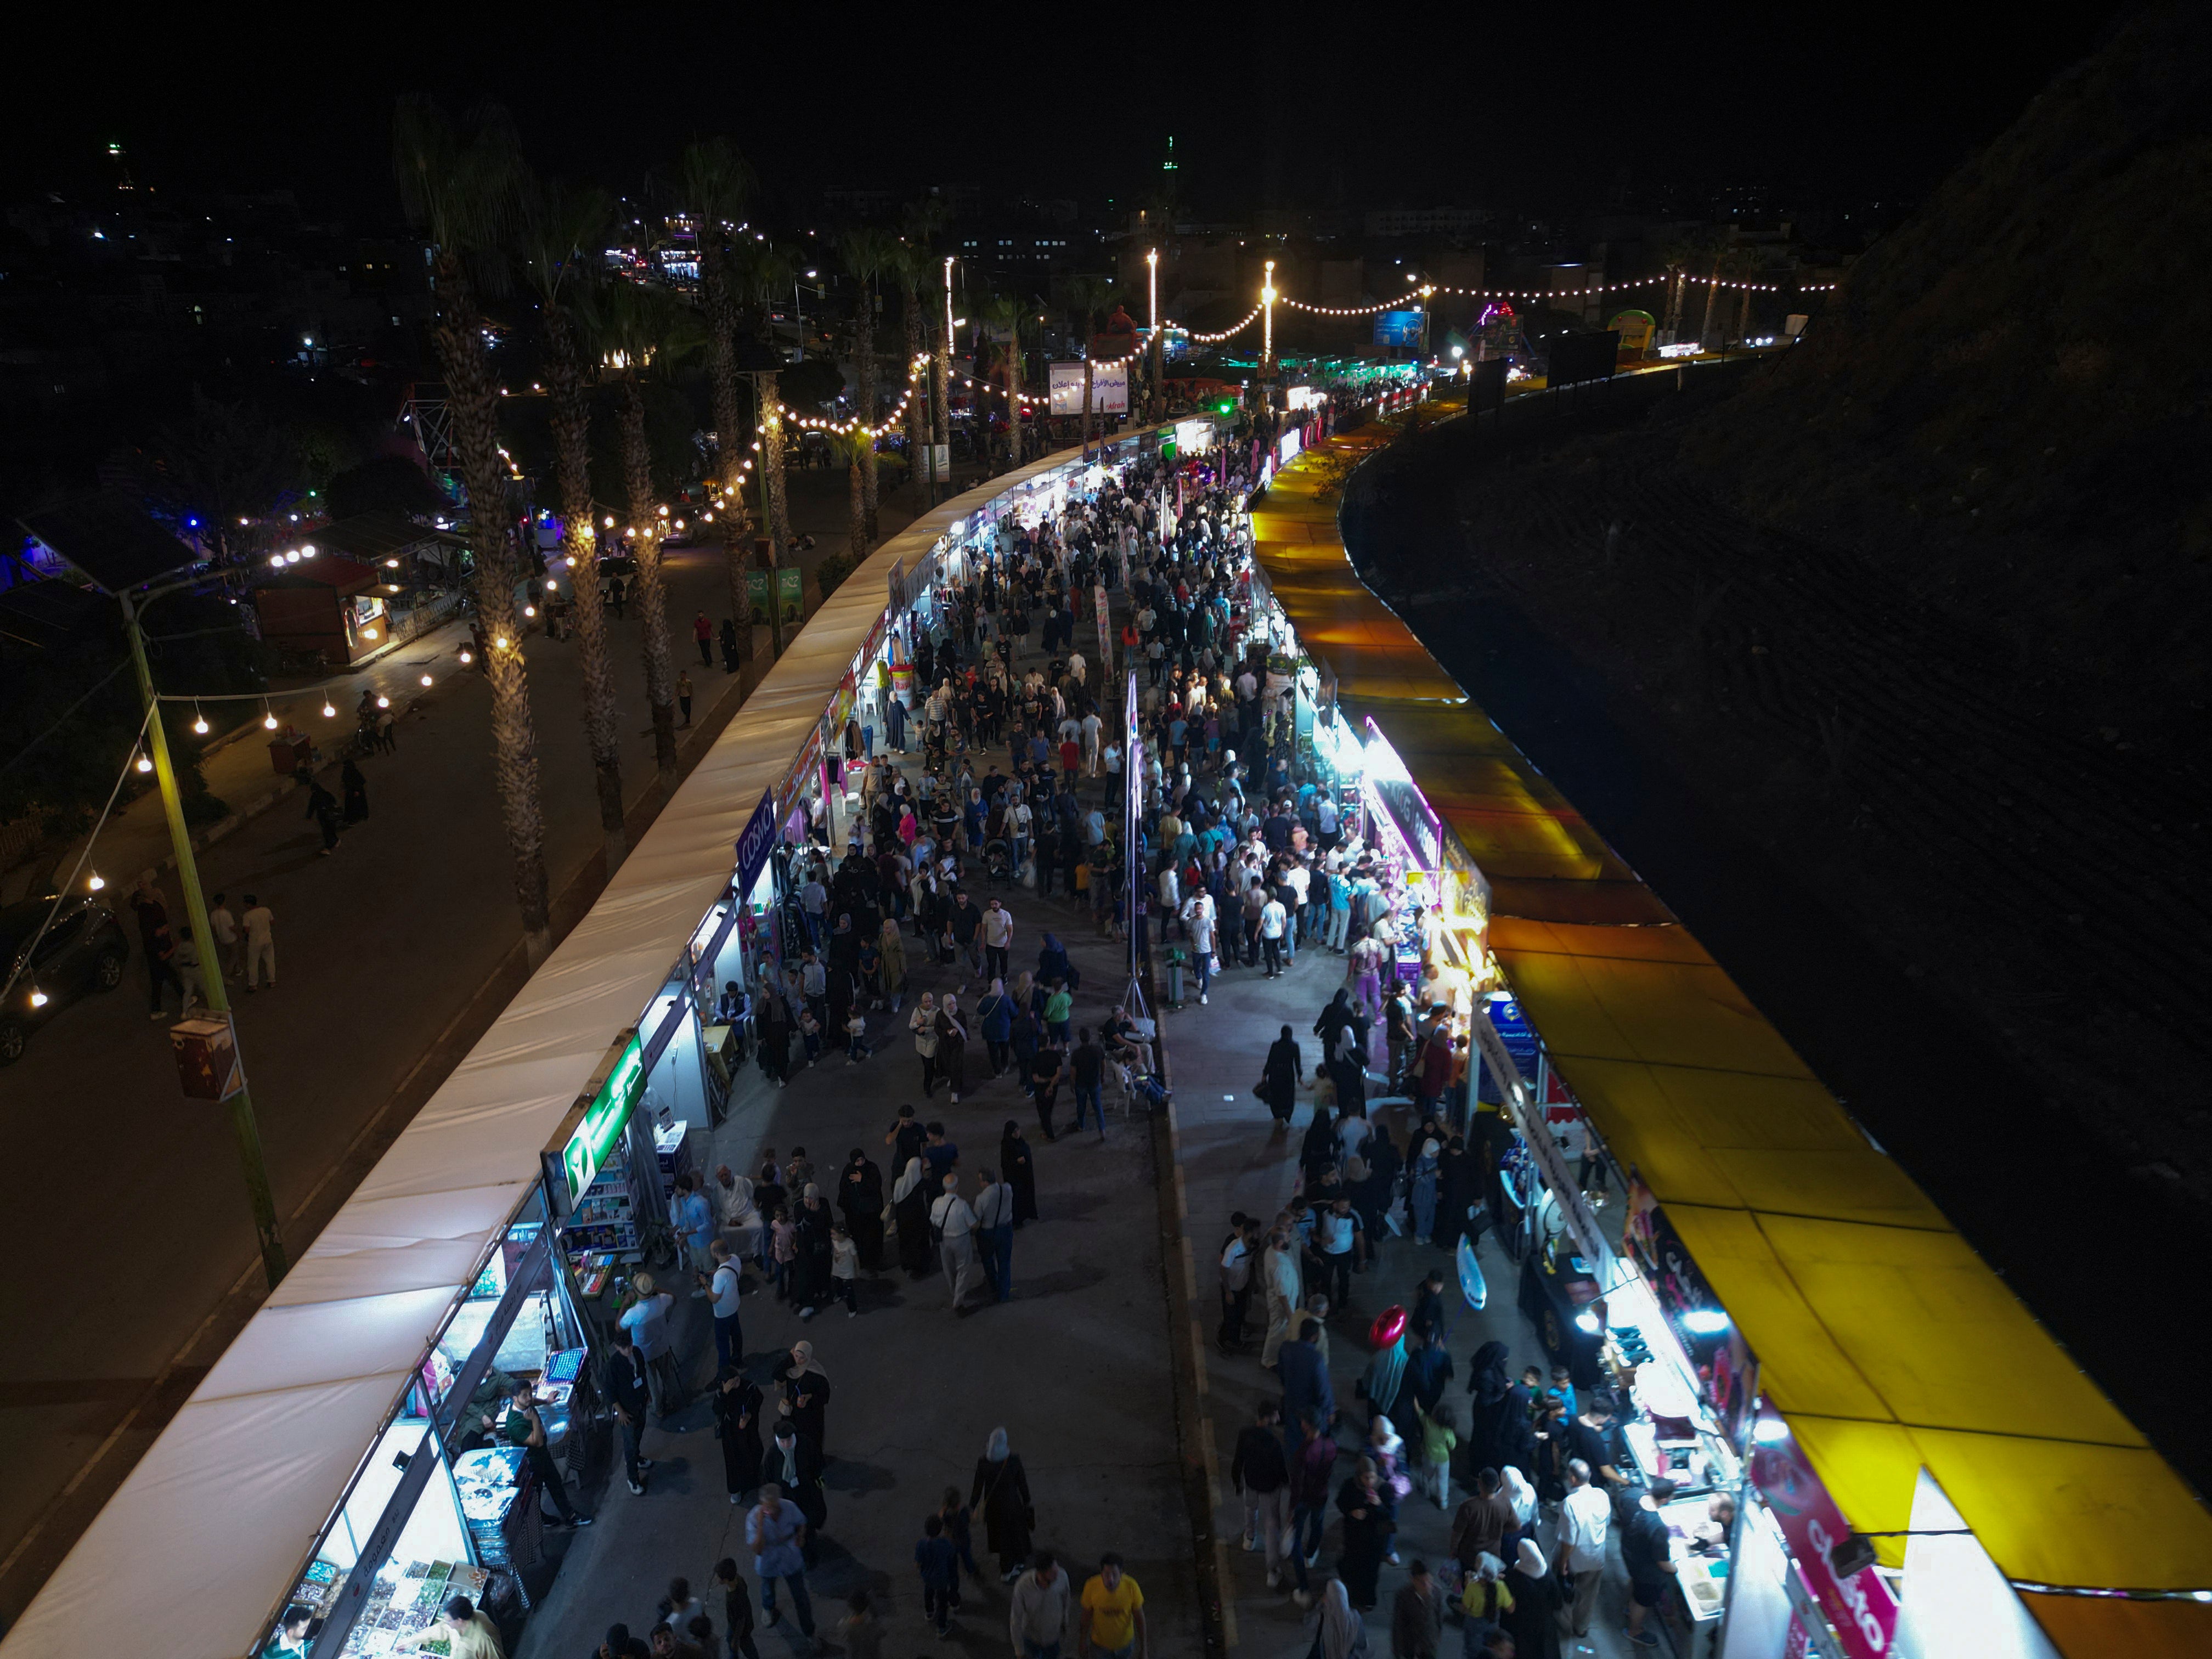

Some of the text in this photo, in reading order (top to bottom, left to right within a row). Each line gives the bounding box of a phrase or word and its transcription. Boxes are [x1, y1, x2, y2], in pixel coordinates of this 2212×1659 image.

[1052, 380, 1070, 389] إعلان
[1092, 379, 1109, 389] الأفراح
[1108, 401, 1125, 410] Afrah
[742, 803, 771, 871] COSMO
